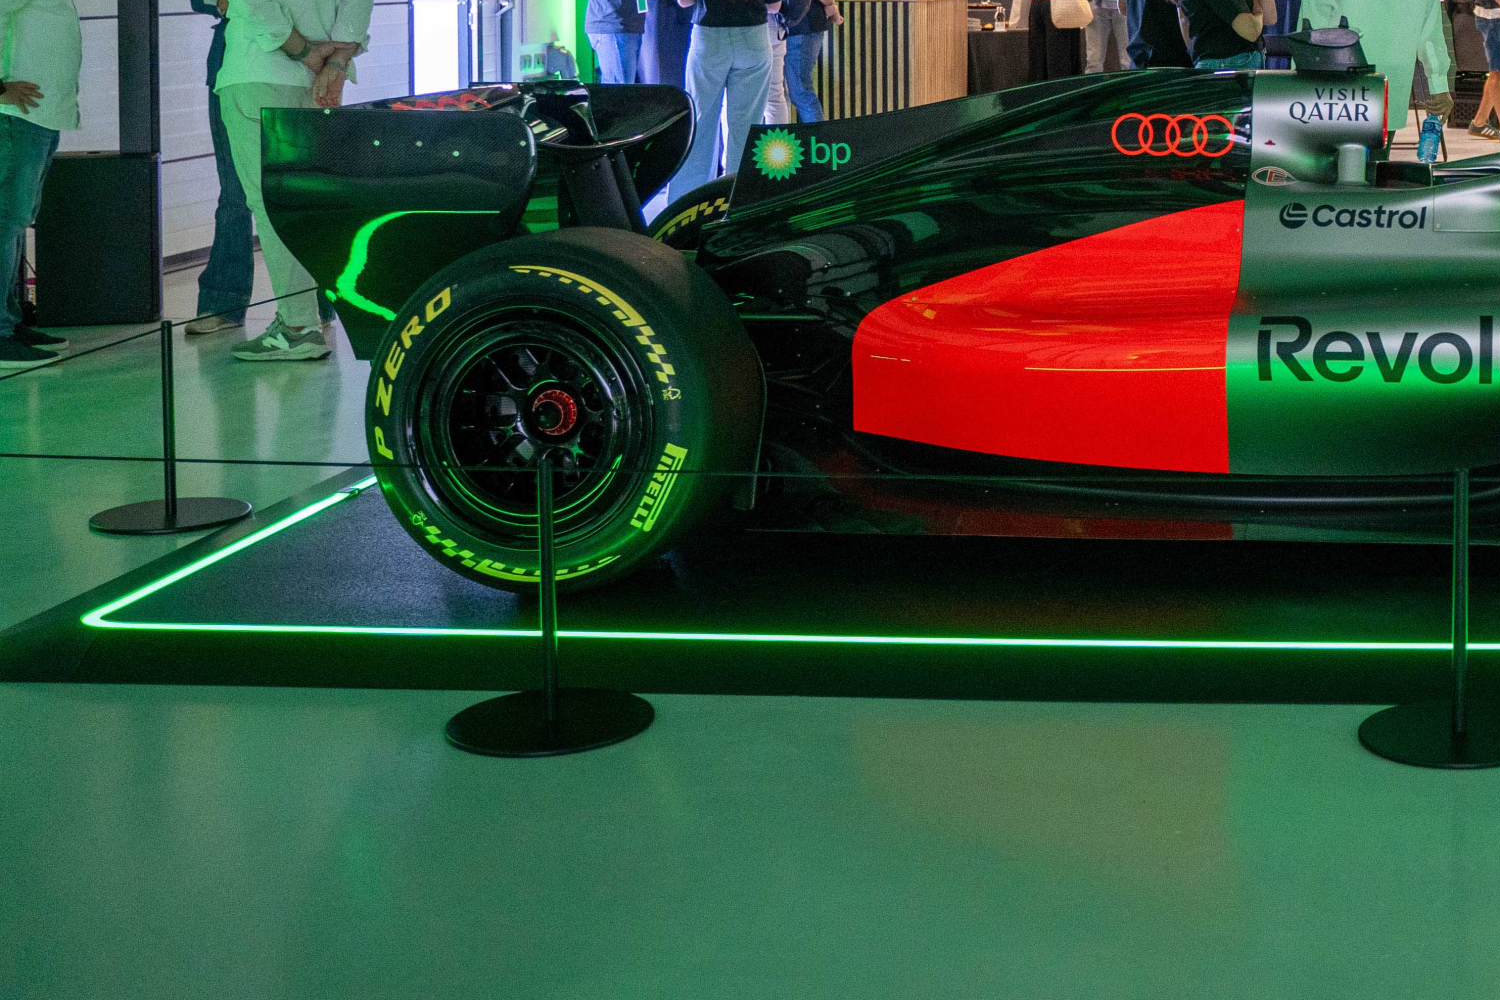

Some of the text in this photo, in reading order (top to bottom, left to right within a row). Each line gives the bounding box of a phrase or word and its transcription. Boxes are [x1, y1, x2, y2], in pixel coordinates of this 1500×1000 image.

[1289, 101, 1370, 124] QATAR
[811, 136, 851, 170] bp
[1312, 204, 1427, 229] Castrol
[374, 286, 451, 460] P ZERO
[630, 443, 688, 531] PIRELLI
